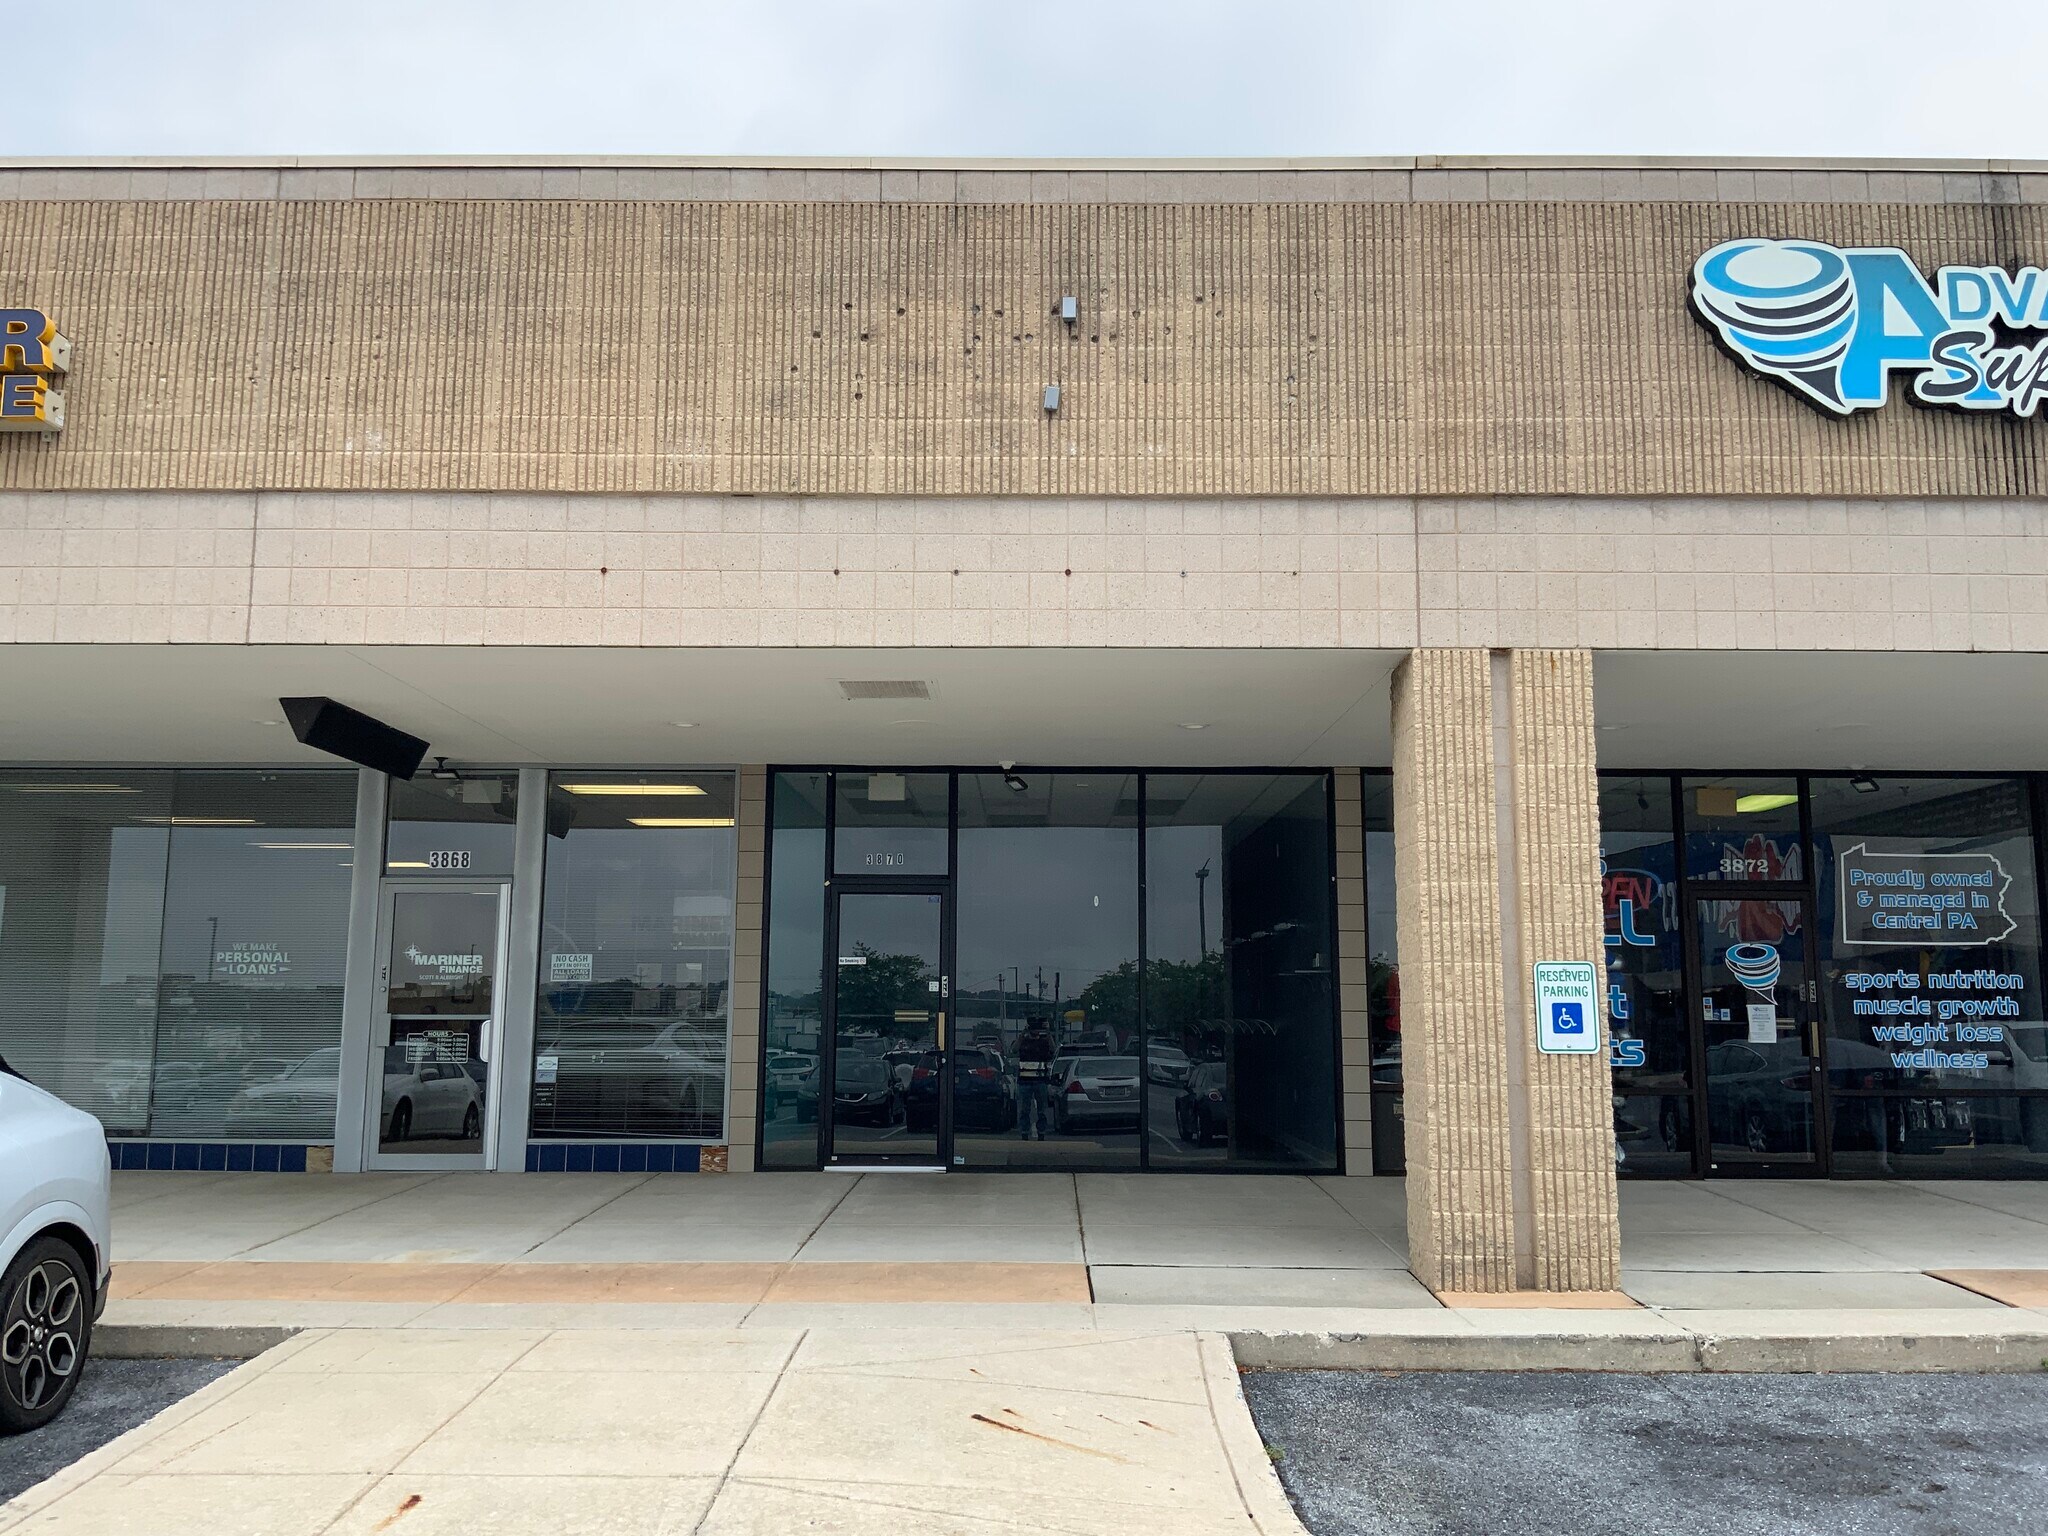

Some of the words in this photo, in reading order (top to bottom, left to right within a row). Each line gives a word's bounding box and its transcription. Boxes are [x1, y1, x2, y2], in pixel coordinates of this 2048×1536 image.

[1840, 254, 2048, 400] ADV
[430, 851, 470, 868] 3868
[866, 853, 904, 865] 3870
[1719, 859, 1769, 873] 3872
[1850, 869, 1925, 889] Proudly
[1930, 870, 1993, 887] owned
[1857, 890, 1873, 907] &
[1879, 892, 1965, 911] managed
[1971, 892, 1990, 908] in
[1872, 911, 1942, 929] Central
[1947, 912, 1978, 930] PA
[232, 943, 247, 951] WE
[250, 943, 278, 951] MAKE
[216, 952, 291, 963] PERSONAL
[414, 954, 483, 965] MARINER
[228, 964, 277, 975] LOANS
[439, 965, 483, 974] FINANCE
[1539, 970, 1591, 982] RESERVED
[1845, 970, 1920, 992] sports
[1928, 970, 2023, 989] nutrition
[1543, 986, 1589, 997] PARKING
[1853, 996, 1931, 1015] muscle
[1938, 996, 2019, 1019] growth
[1872, 1022, 1949, 1046] weight
[1956, 1022, 2004, 1042] loss
[1891, 1049, 1988, 1068] wellness
